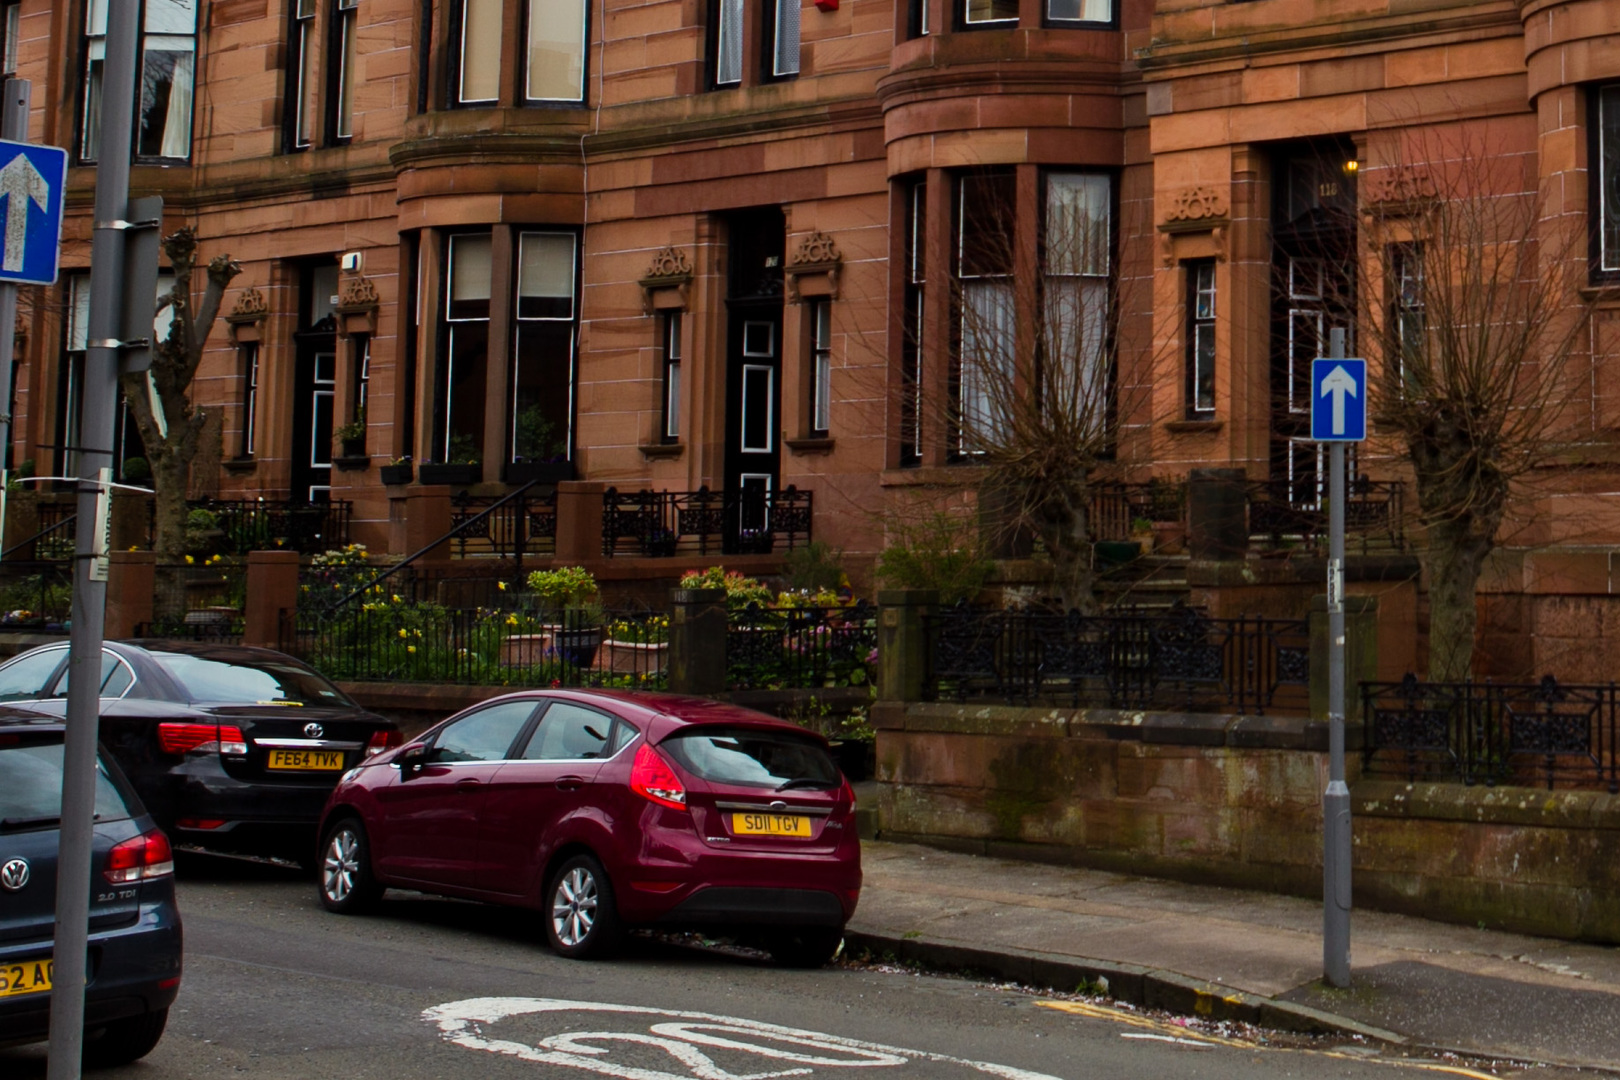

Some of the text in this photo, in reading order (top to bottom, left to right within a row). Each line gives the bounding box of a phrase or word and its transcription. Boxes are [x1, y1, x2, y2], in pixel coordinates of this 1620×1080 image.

[274, 751, 339, 767] FE64 TVK
[744, 815, 800, 832] SD11 TGV
[98, 889, 137, 902] 2.0 TDI
